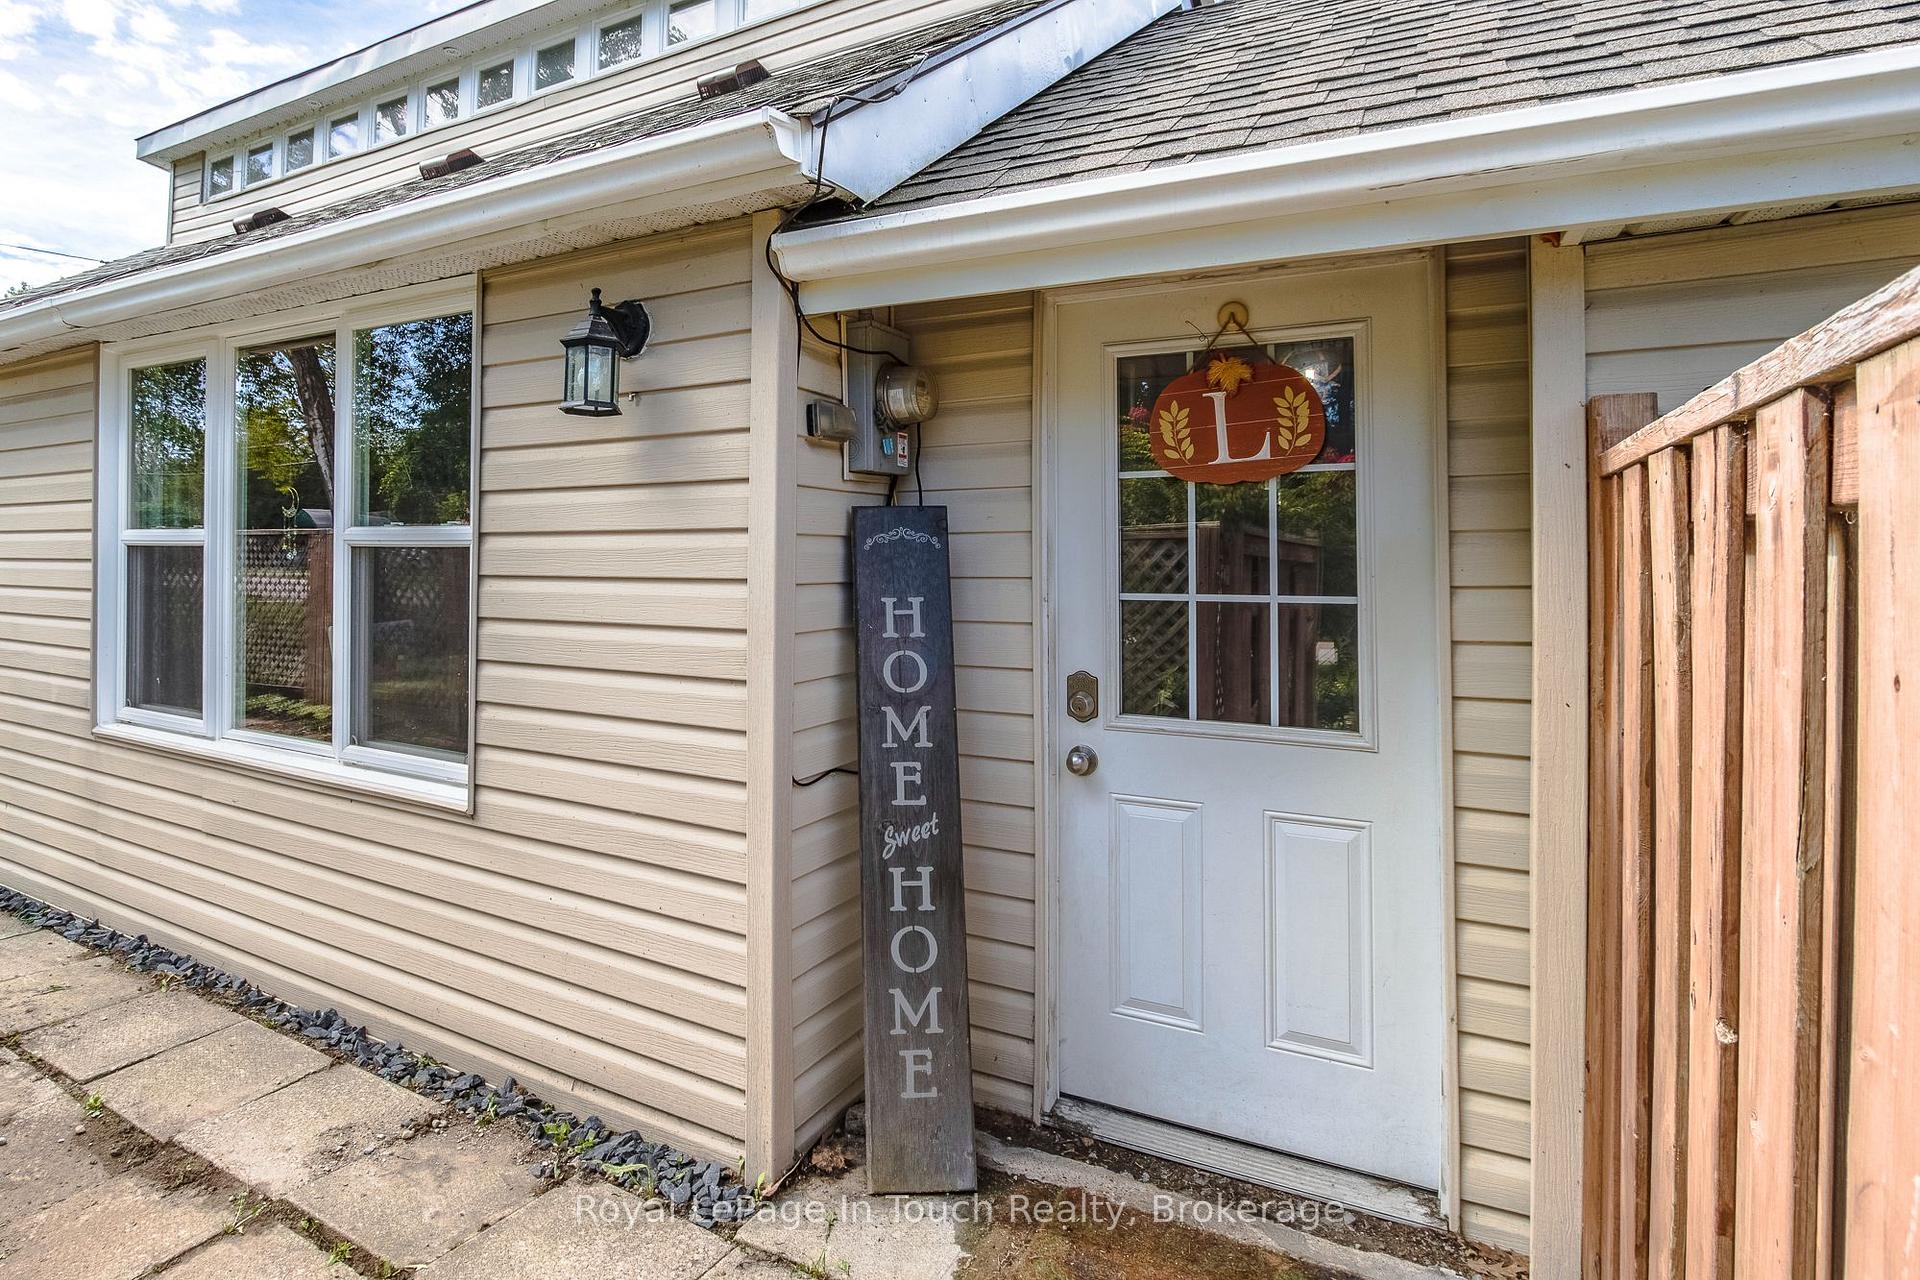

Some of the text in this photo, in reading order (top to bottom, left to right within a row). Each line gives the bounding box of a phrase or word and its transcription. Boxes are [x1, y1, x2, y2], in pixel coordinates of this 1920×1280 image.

[1202, 391, 1271, 465] L
[880, 596, 933, 806] HOME
[882, 812, 940, 860] Sweet
[888, 866, 944, 1099] HOME
